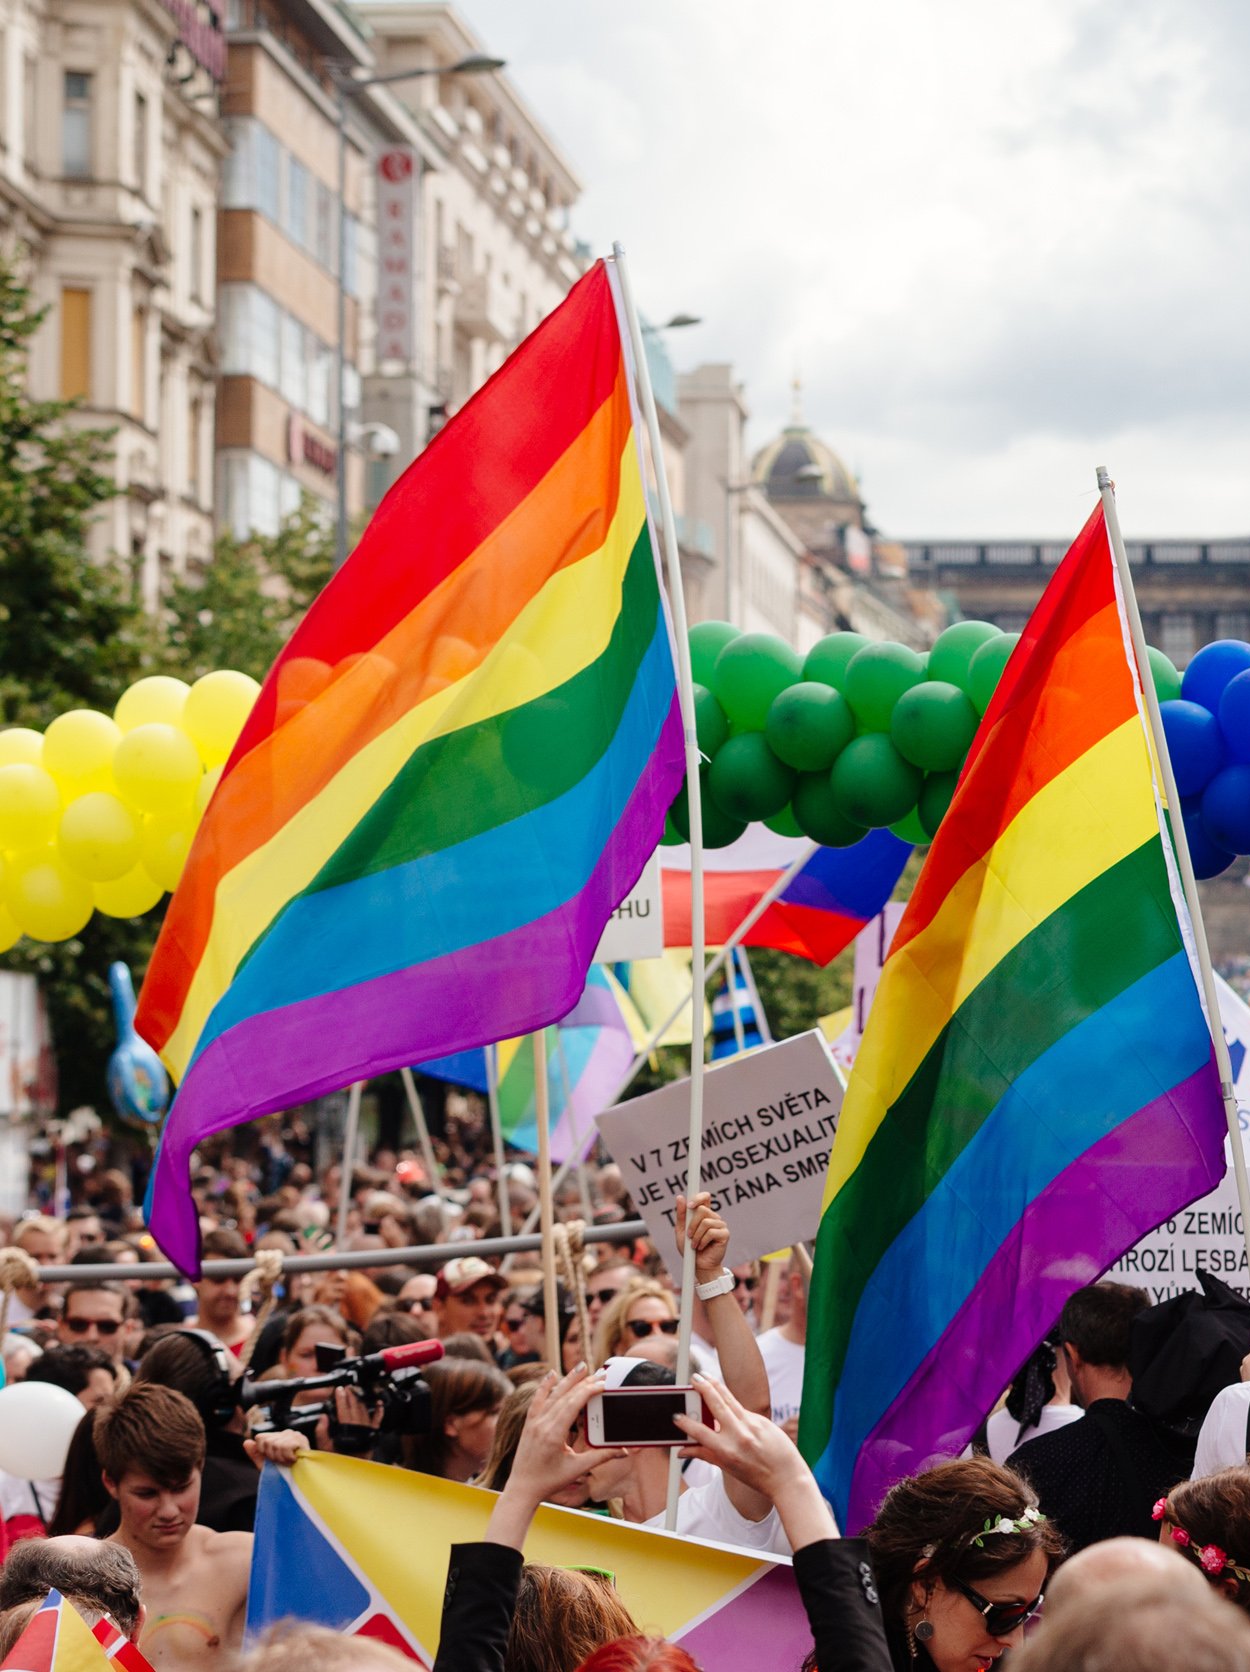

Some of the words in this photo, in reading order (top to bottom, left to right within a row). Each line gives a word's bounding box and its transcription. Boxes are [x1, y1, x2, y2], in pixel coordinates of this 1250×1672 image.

[611, 898, 650, 919] HU
[631, 1154, 646, 1174] V
[650, 1149, 663, 1167] 7
[756, 1087, 831, 1127] SVĚTA
[782, 1148, 834, 1183] SMR
[637, 1182, 664, 1206] JE
